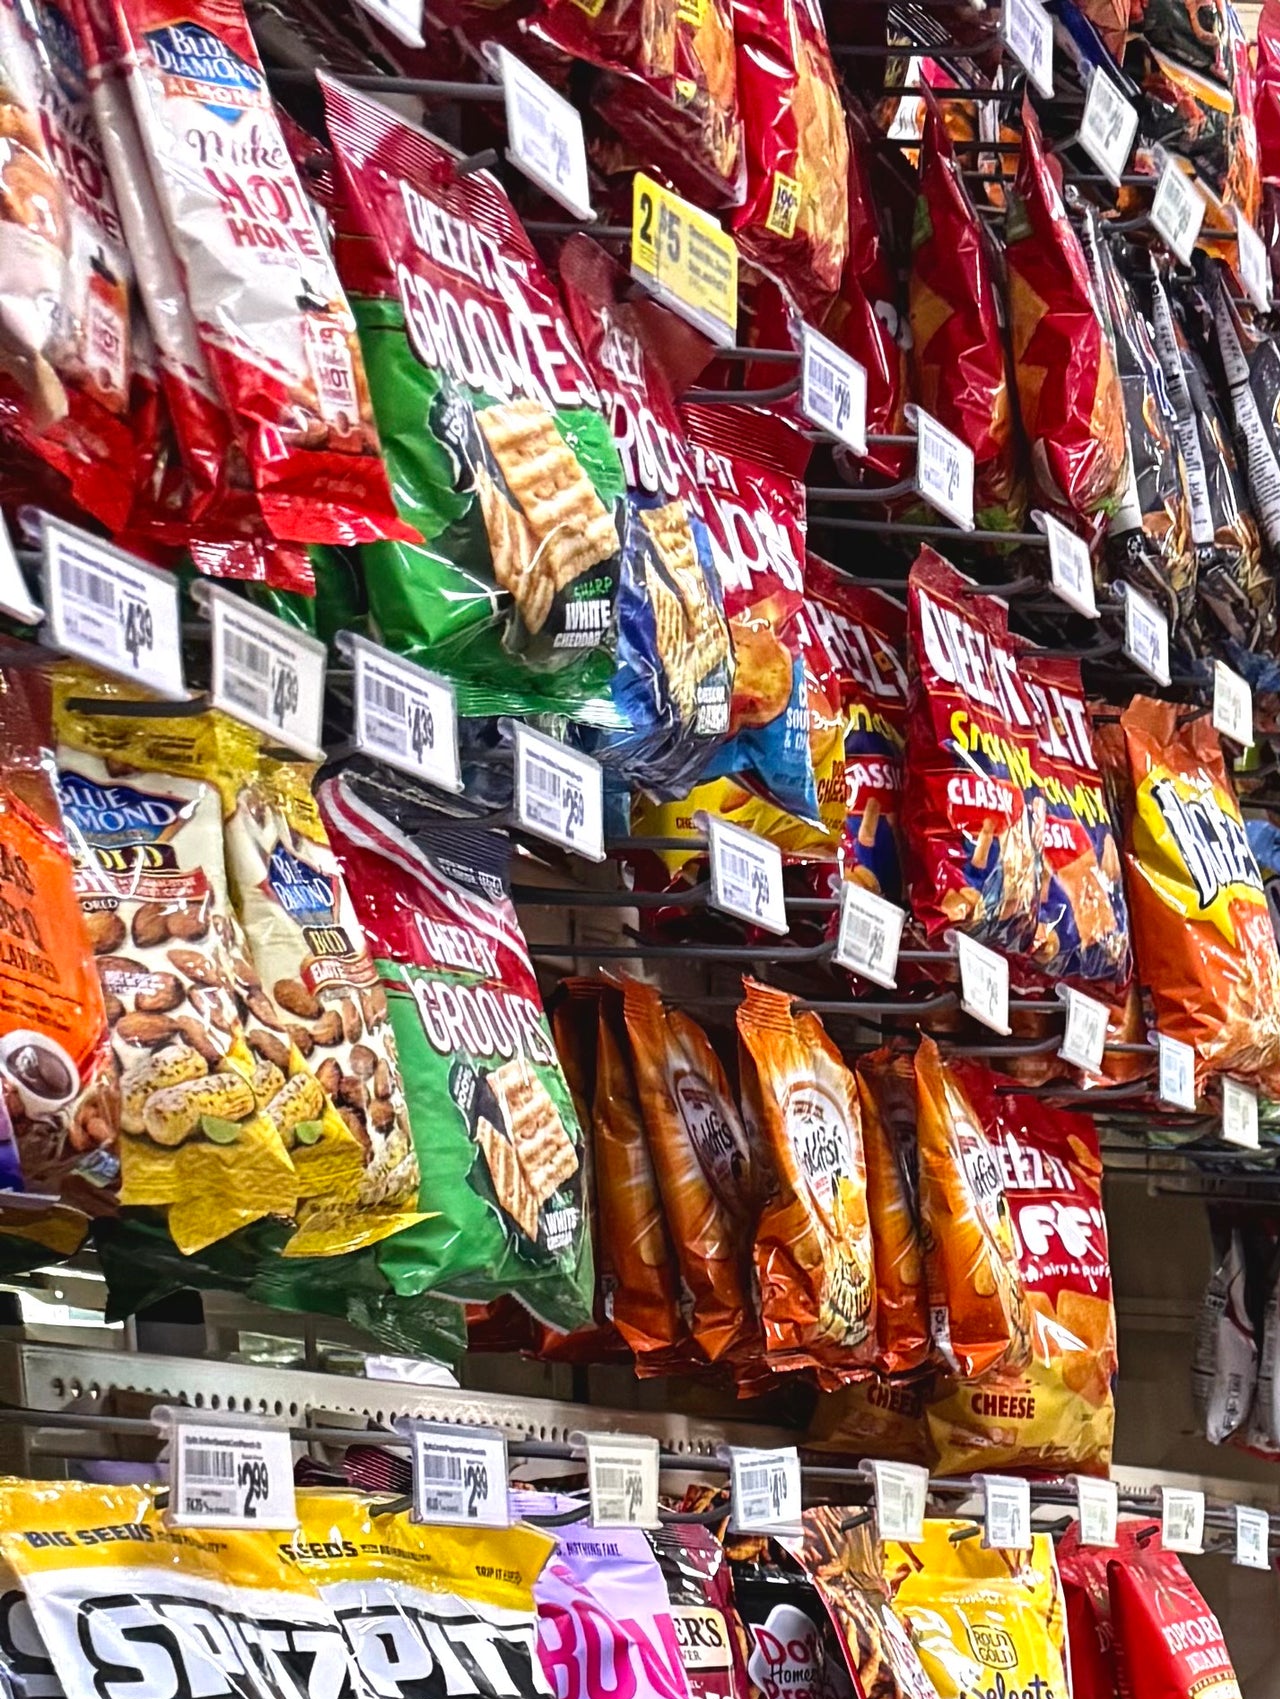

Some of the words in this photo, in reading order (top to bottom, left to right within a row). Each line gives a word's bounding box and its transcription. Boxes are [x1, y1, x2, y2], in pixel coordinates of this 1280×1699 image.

[150, 42, 264, 88] DIAMOND
[227, 218, 321, 261] HONE
[565, 599, 611, 632] WHITE
[422, 977, 560, 1067] GROOVES
[971, 1391, 1036, 1420] CHEESE
[24, 1527, 72, 1549] BIG
[75, 1522, 156, 1546] SEEDS
[975, 1630, 1009, 1650] ROLD
